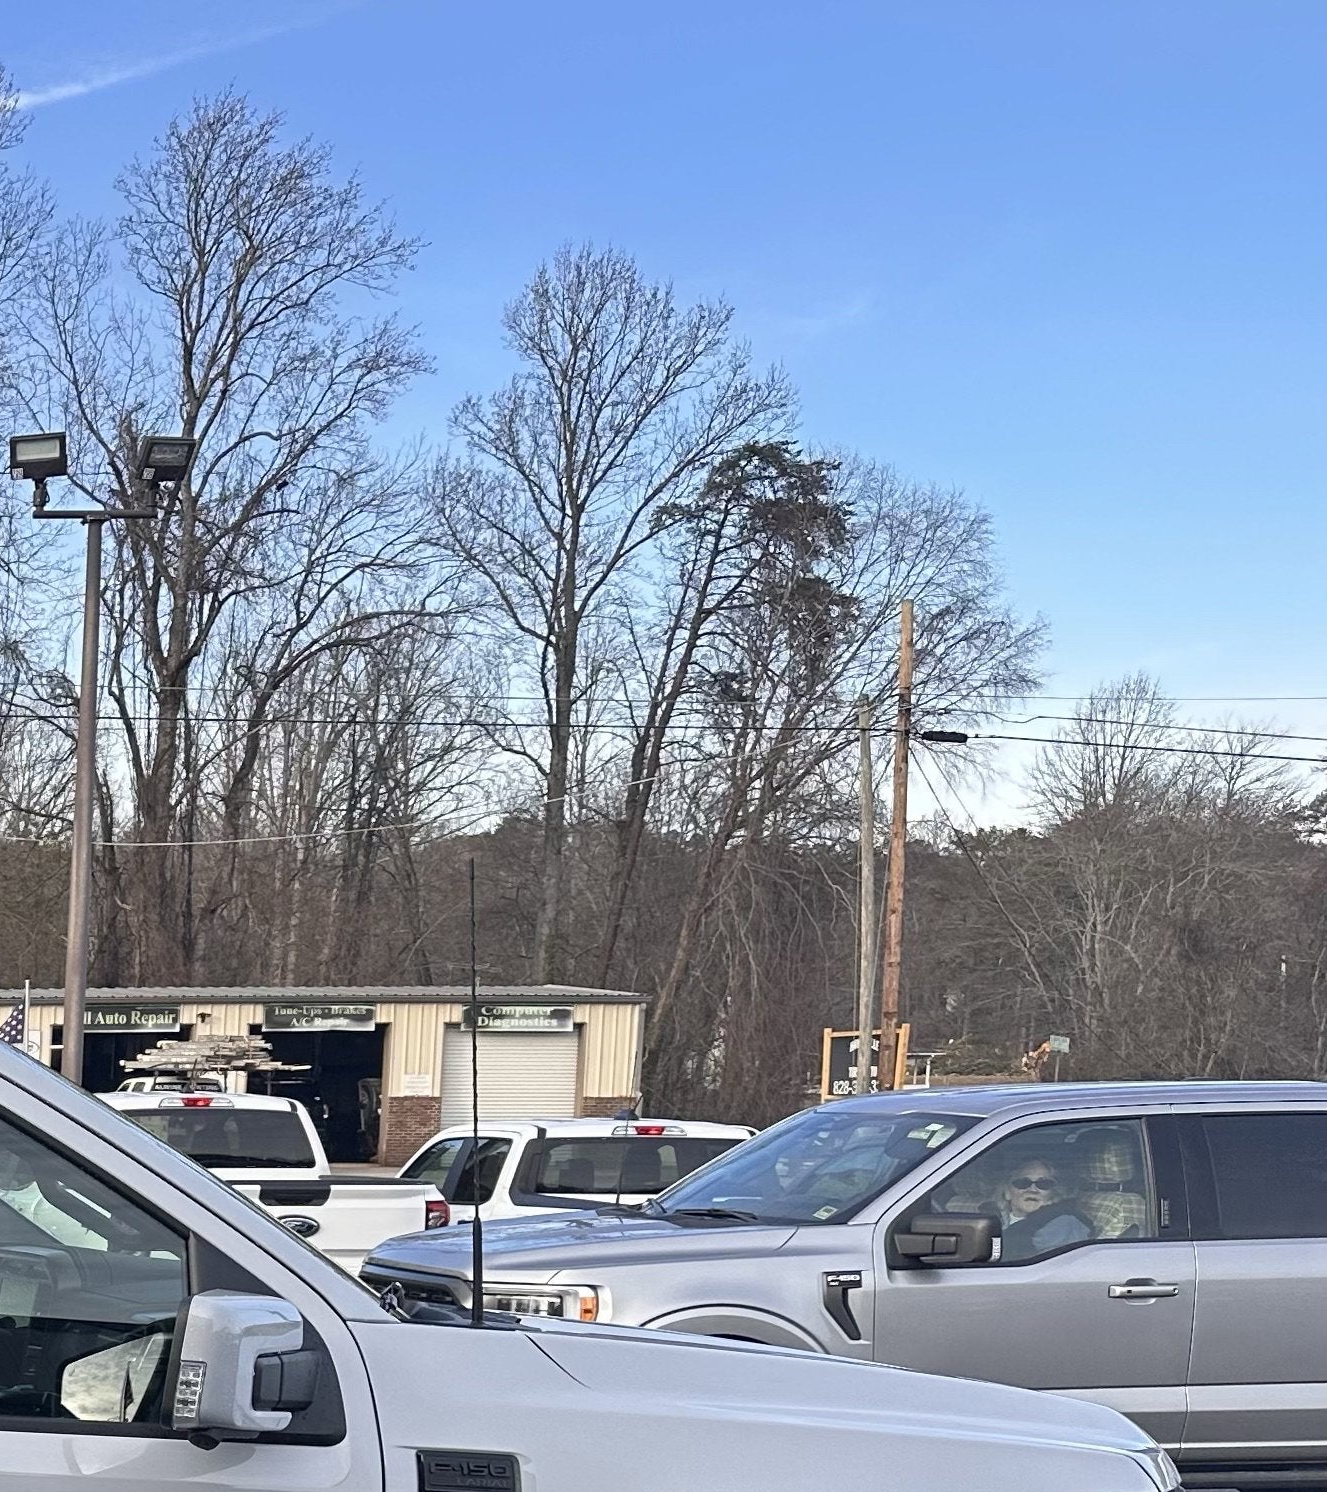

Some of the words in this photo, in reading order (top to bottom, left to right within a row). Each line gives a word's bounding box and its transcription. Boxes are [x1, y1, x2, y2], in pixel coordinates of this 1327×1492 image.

[94, 1011, 127, 1025] Auto
[131, 1010, 176, 1028] Repair
[481, 1005, 551, 1018] Computer
[477, 1016, 559, 1029] Diagnostics
[428, 1461, 511, 1479] F-150
